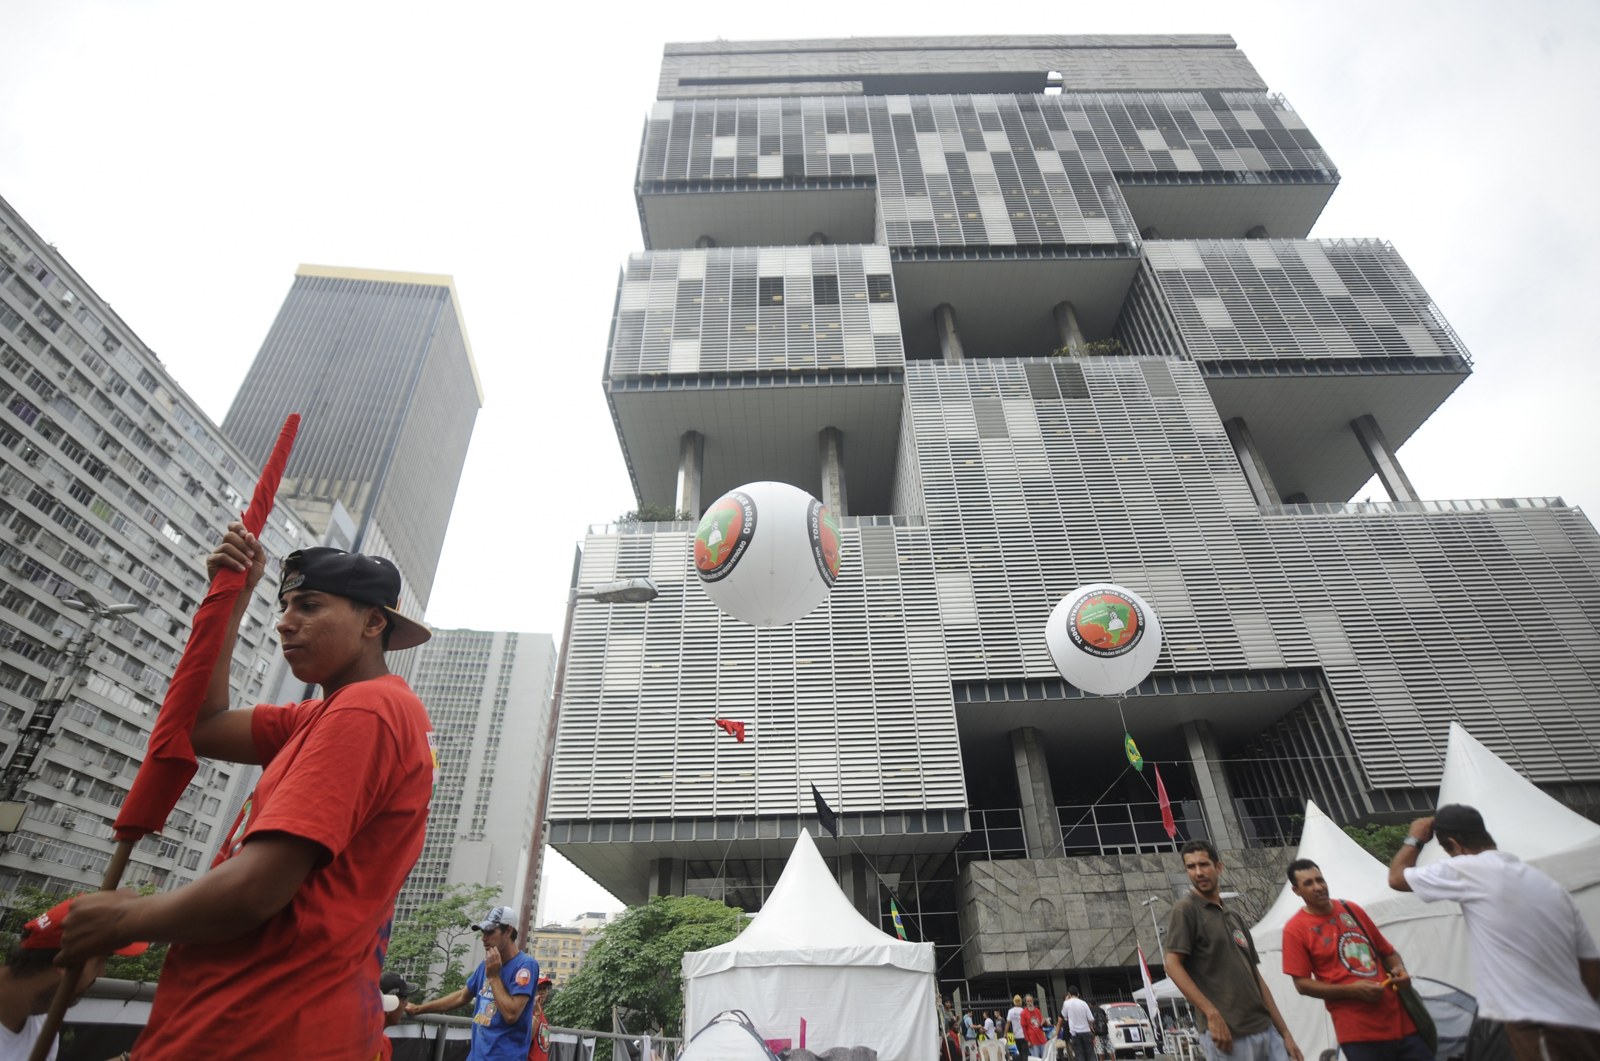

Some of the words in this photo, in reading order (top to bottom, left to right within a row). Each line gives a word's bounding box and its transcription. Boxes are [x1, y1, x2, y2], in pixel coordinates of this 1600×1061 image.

[743, 505, 753, 535] NOSSO
[730, 540, 747, 565] PETRÓLEO
[1069, 595, 1089, 626] PETRÓLEO
[1120, 594, 1133, 604] SER
[1132, 603, 1144, 626] NOSSO
[1070, 626, 1083, 645] TODO
[1084, 645, 1094, 653] NÃO
